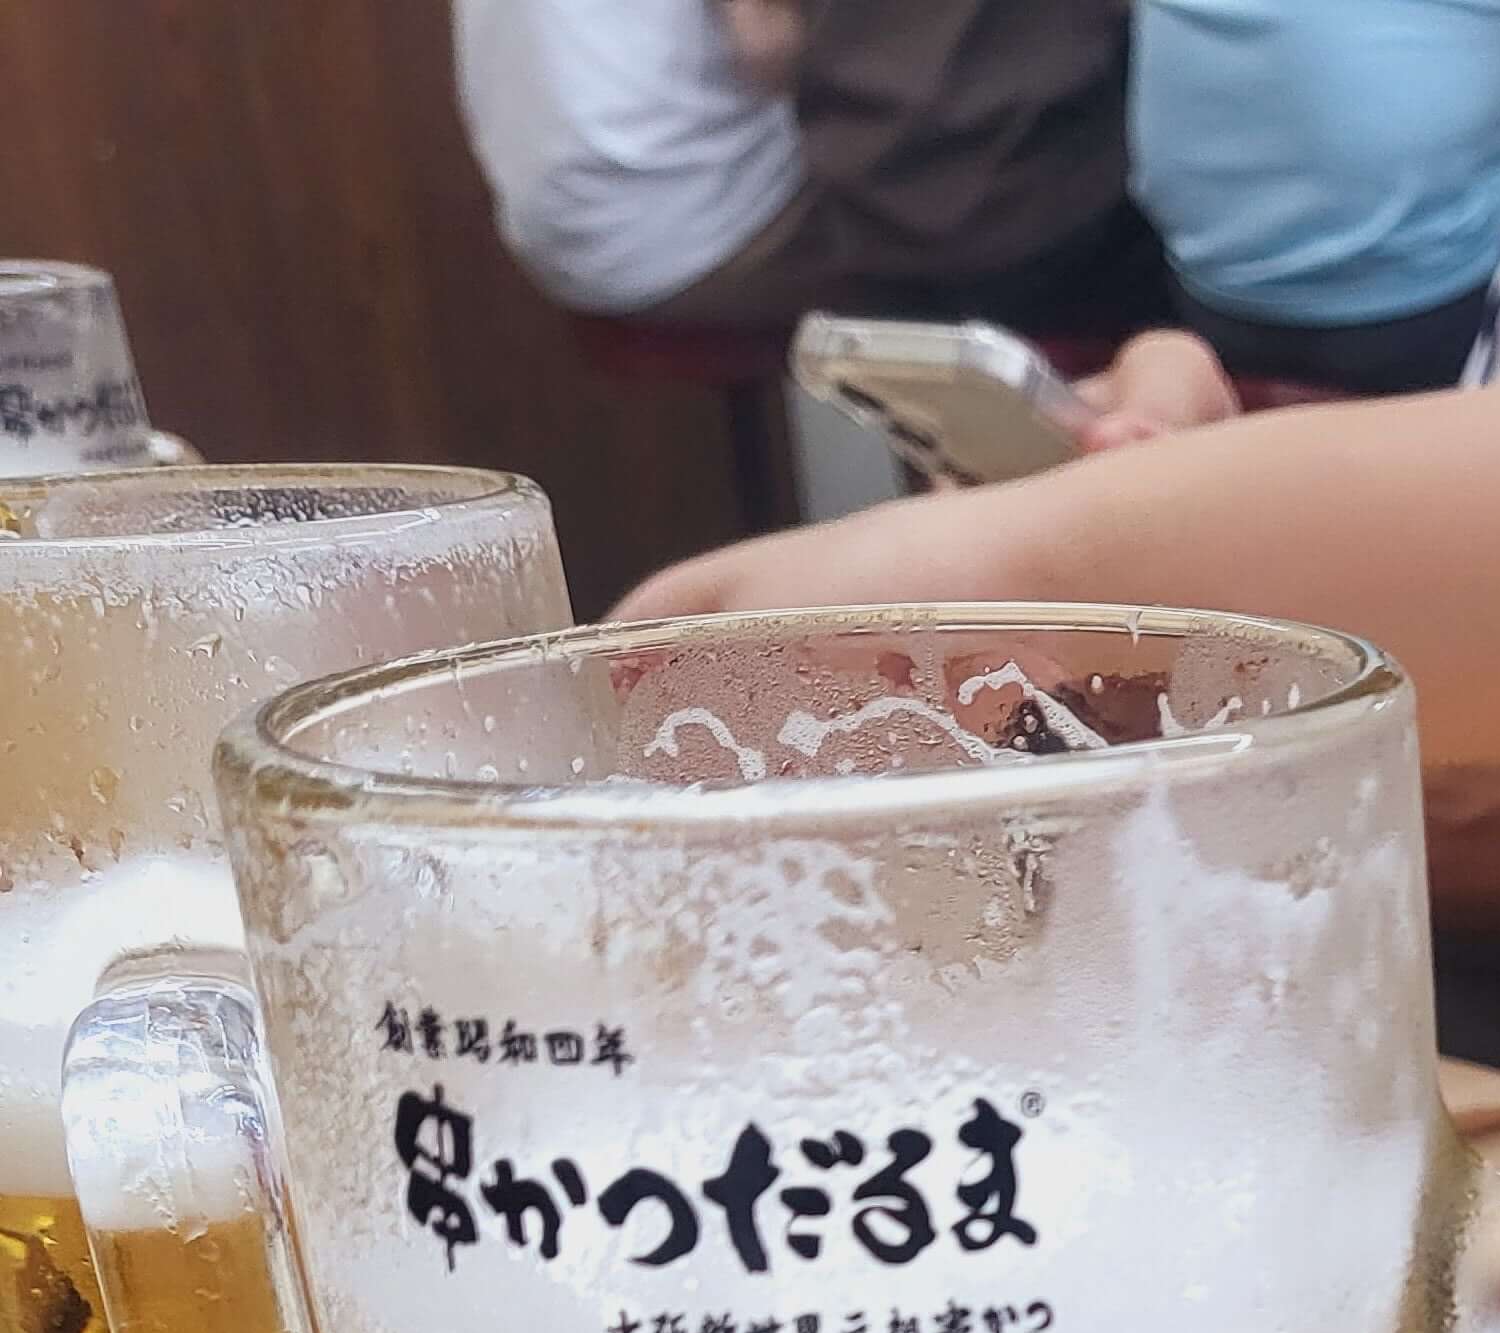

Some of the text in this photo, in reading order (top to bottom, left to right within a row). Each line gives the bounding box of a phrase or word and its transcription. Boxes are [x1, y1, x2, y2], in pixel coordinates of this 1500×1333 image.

[395, 1083, 1037, 1274] 串かつだるま
